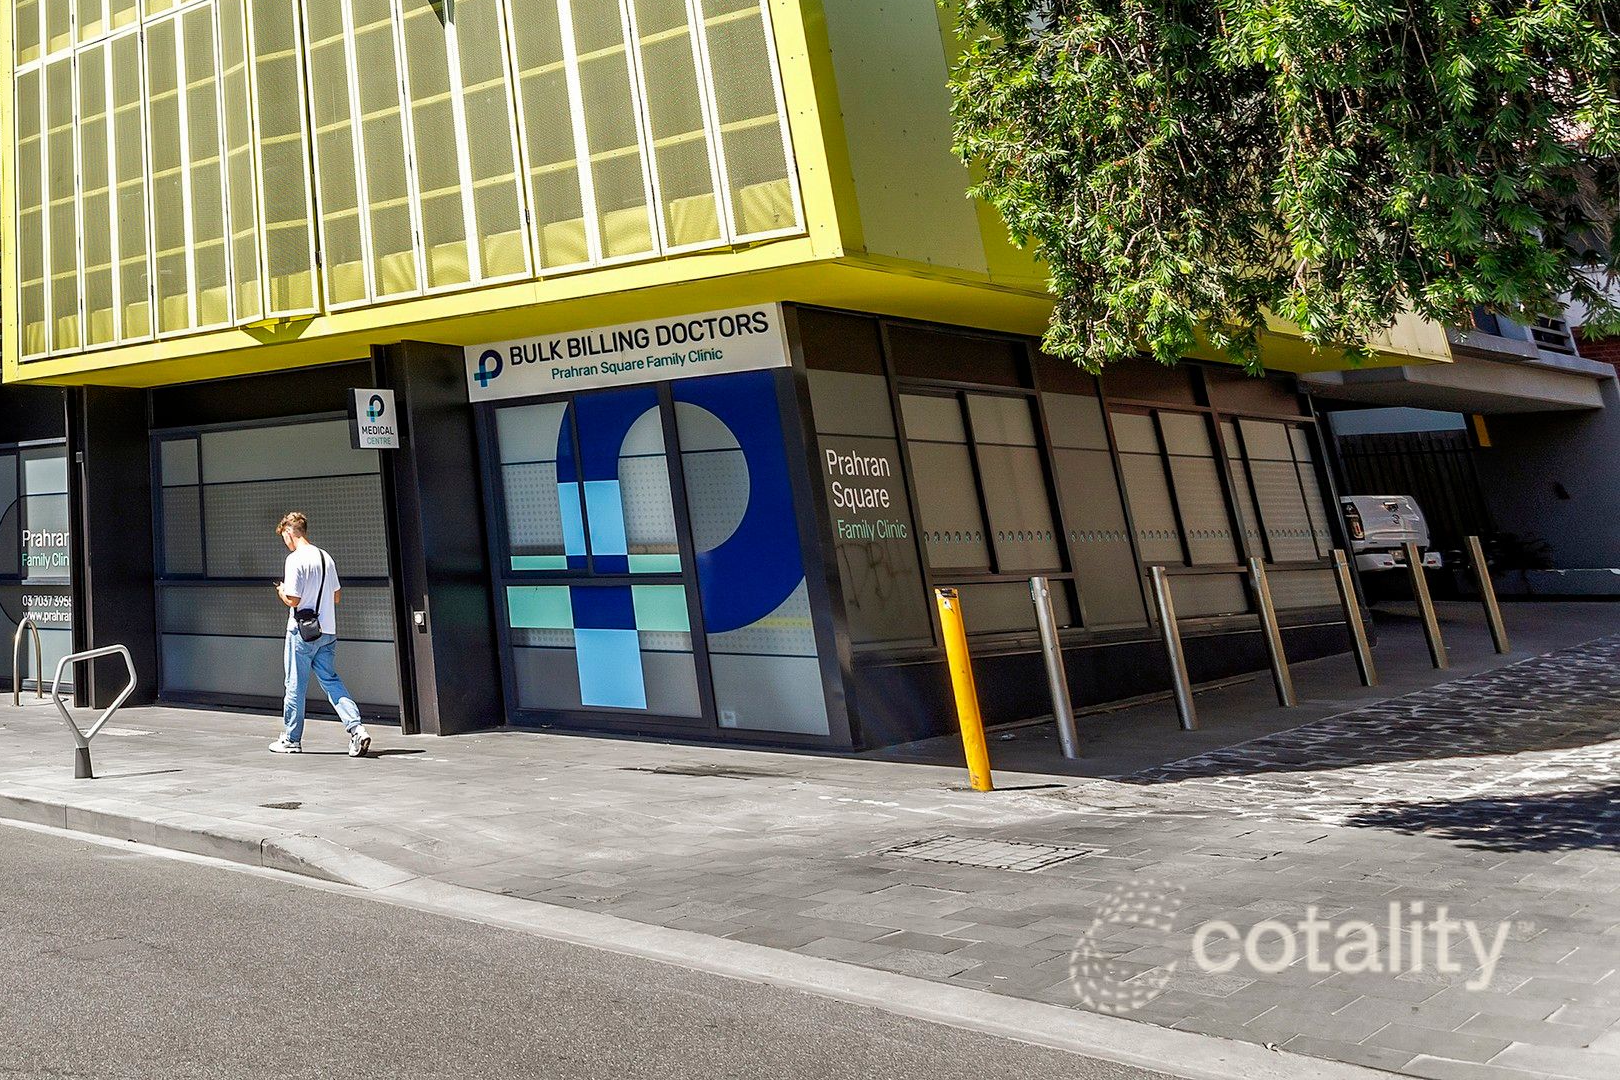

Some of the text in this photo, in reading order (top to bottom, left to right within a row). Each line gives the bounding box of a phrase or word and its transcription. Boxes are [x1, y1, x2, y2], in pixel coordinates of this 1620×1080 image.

[509, 311, 770, 366] BULK BILLING DOCTORS
[551, 347, 724, 380] Prahran Square Family Clinic
[361, 425, 394, 435] MEDICAL
[366, 436, 392, 445] CENTRE
[825, 448, 891, 477] Prahran
[831, 481, 890, 514] Square
[837, 519, 908, 541] Family Clinic
[21, 552, 51, 570] Family
[22, 595, 34, 607] 03
[34, 595, 53, 607] 7037
